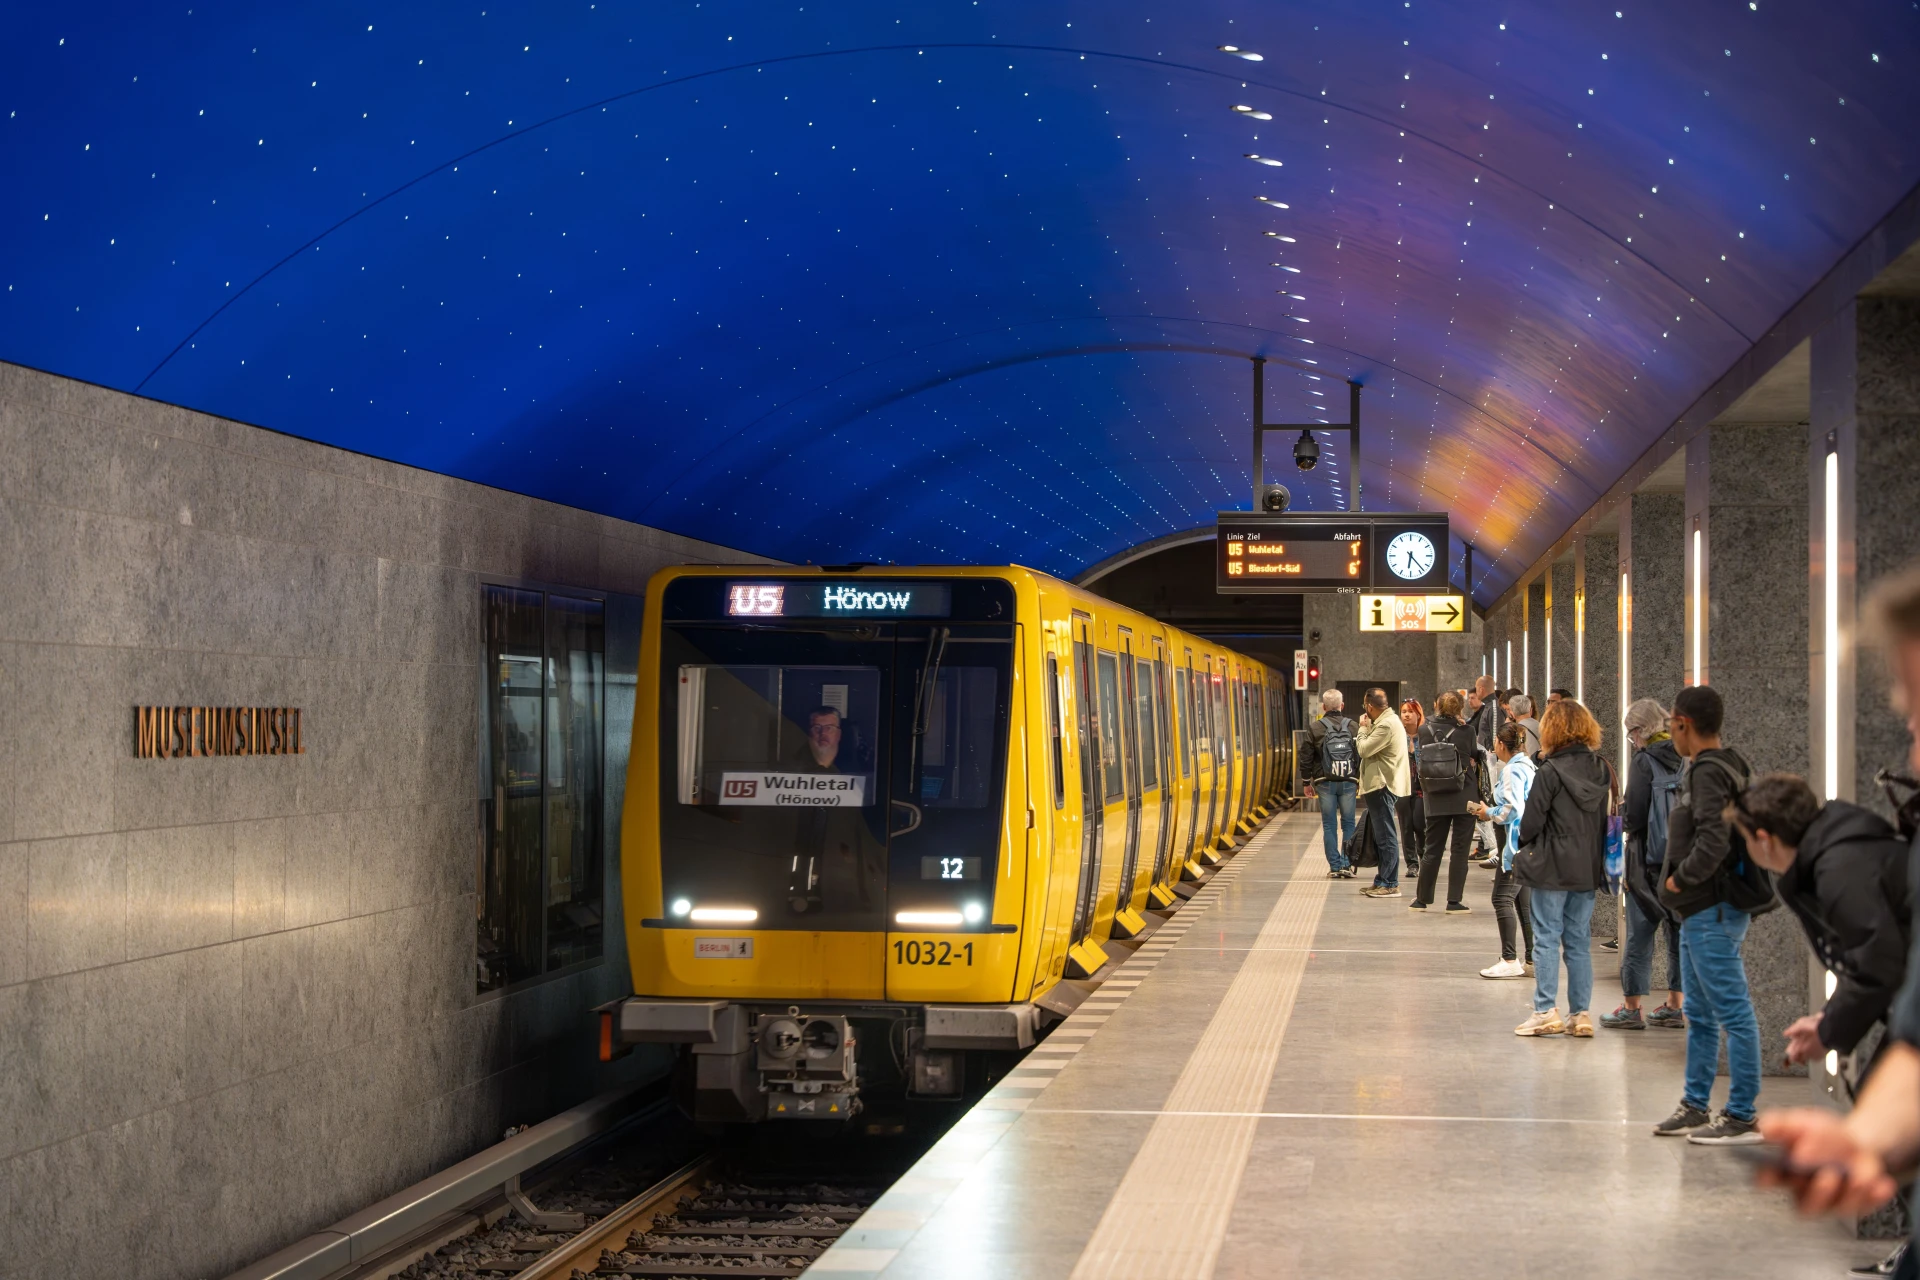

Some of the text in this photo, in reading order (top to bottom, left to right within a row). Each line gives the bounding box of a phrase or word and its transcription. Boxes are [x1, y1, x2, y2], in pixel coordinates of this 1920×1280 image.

[1227, 533, 1261, 541] Linie Ziel
[1334, 533, 1361, 541] Abfahrt
[1228, 543, 1243, 556] U5
[1248, 545, 1284, 554] Wuhletal
[1228, 562, 1243, 575] U5
[1248, 564, 1301, 573] Biesdorf-Süd
[734, 587, 911, 613] U5 Hönow
[1401, 620, 1420, 629] SOS
[134, 706, 306, 759] MUSEUMSINSEL
[727, 776, 855, 796] U5 Wuhletal
[775, 794, 842, 807] (Hönow)
[940, 857, 964, 879] 12
[893, 940, 974, 966] 1032-1
